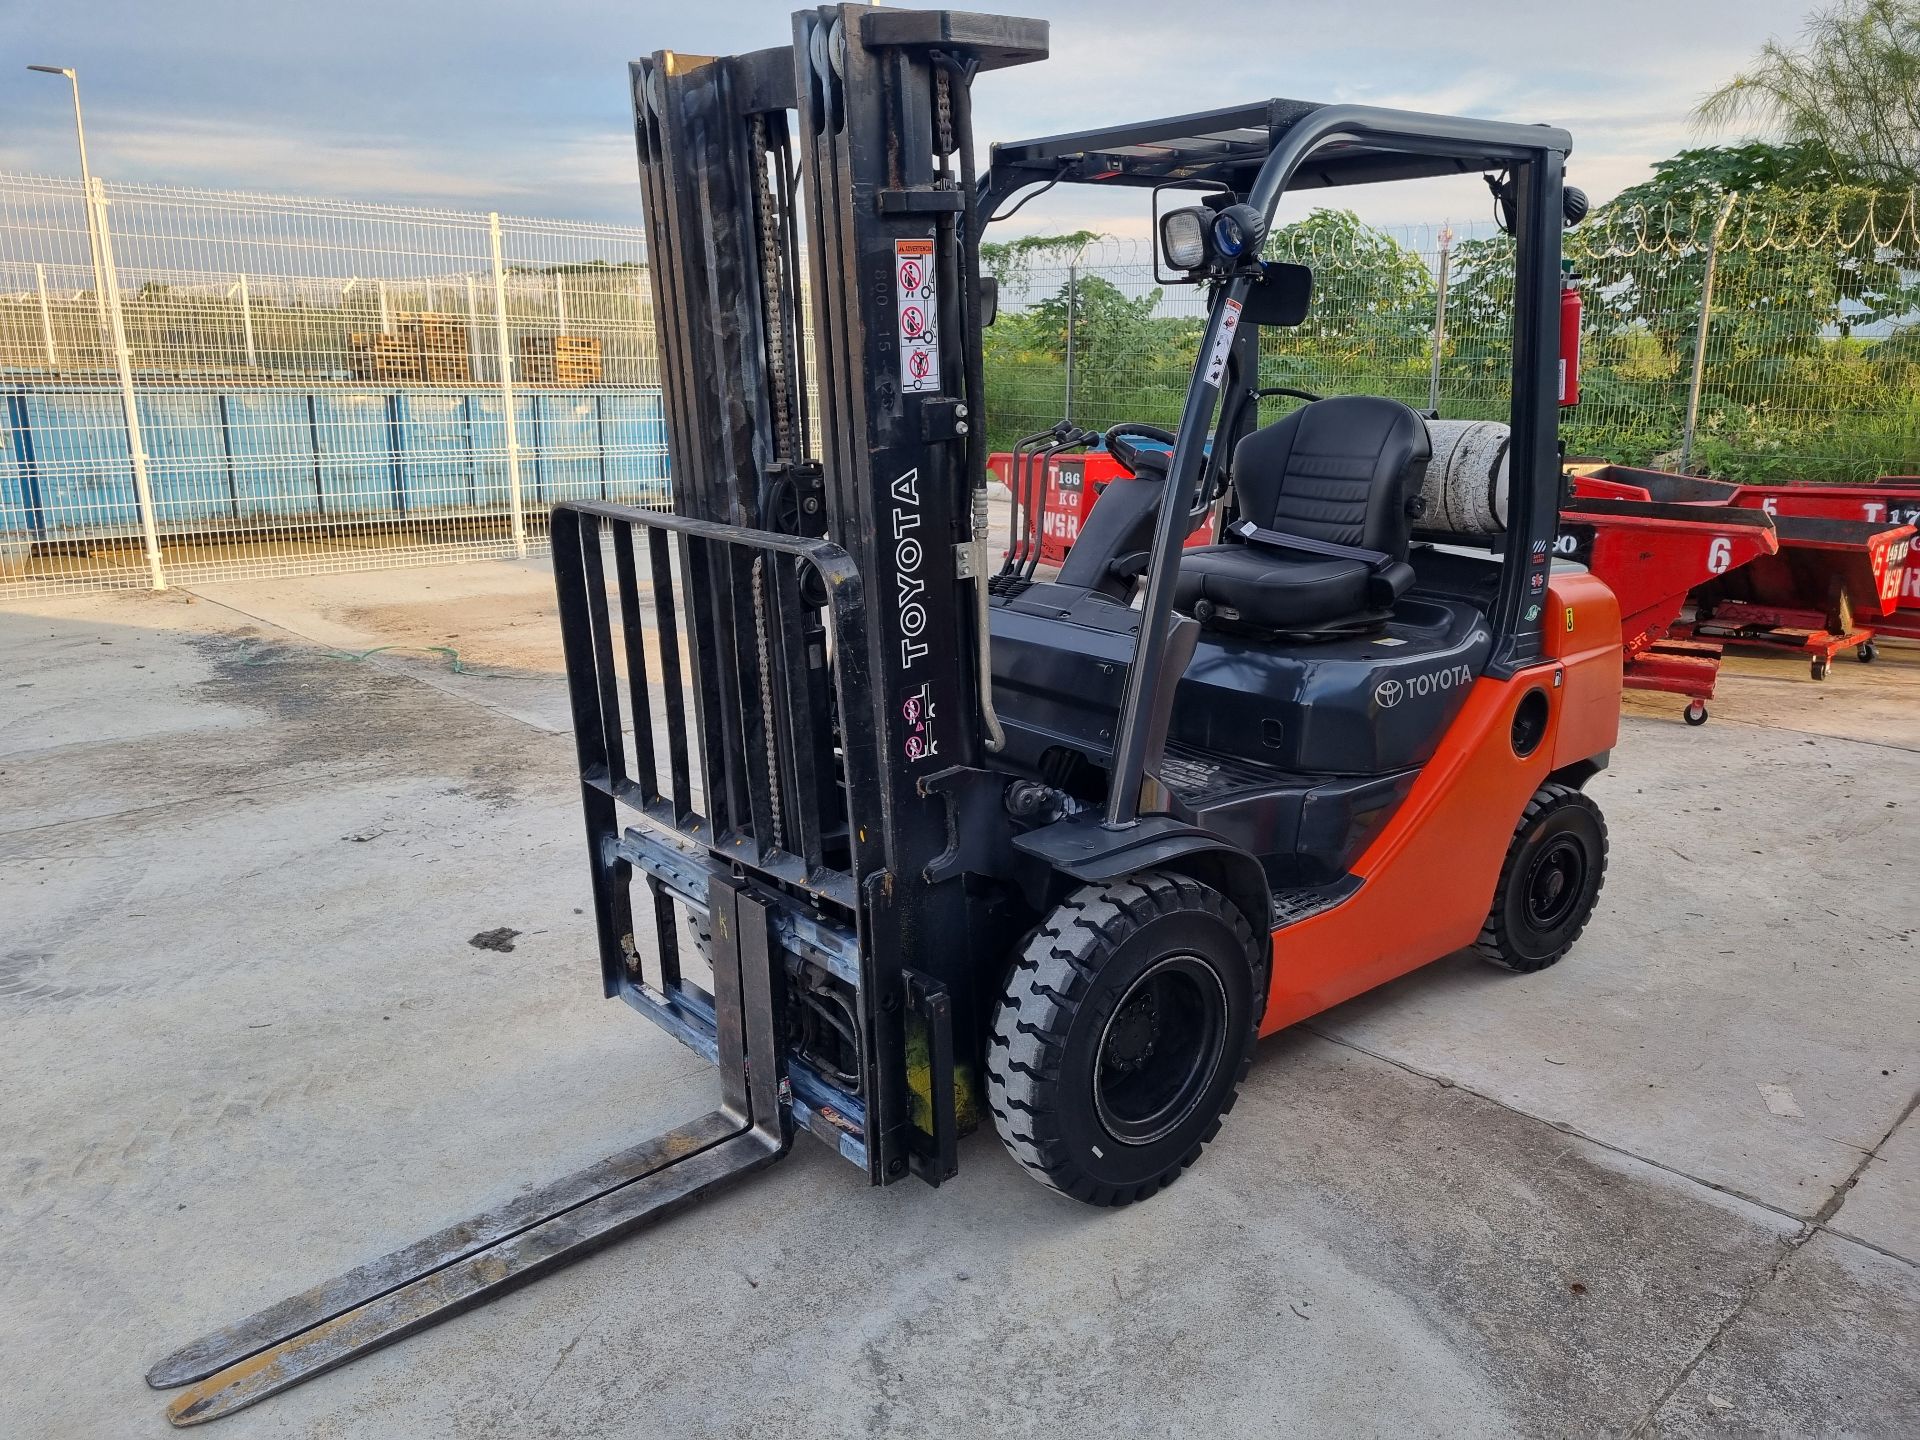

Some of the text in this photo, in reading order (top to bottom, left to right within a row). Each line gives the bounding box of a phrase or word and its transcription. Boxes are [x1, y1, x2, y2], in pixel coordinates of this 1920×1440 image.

[1058, 471, 1081, 486] 186
[1043, 510, 1079, 540] WSR
[1862, 503, 1885, 523] T
[891, 467, 929, 669] TOYOTA
[1707, 537, 1732, 574] 6
[1406, 664, 1472, 699] TOYOTA
